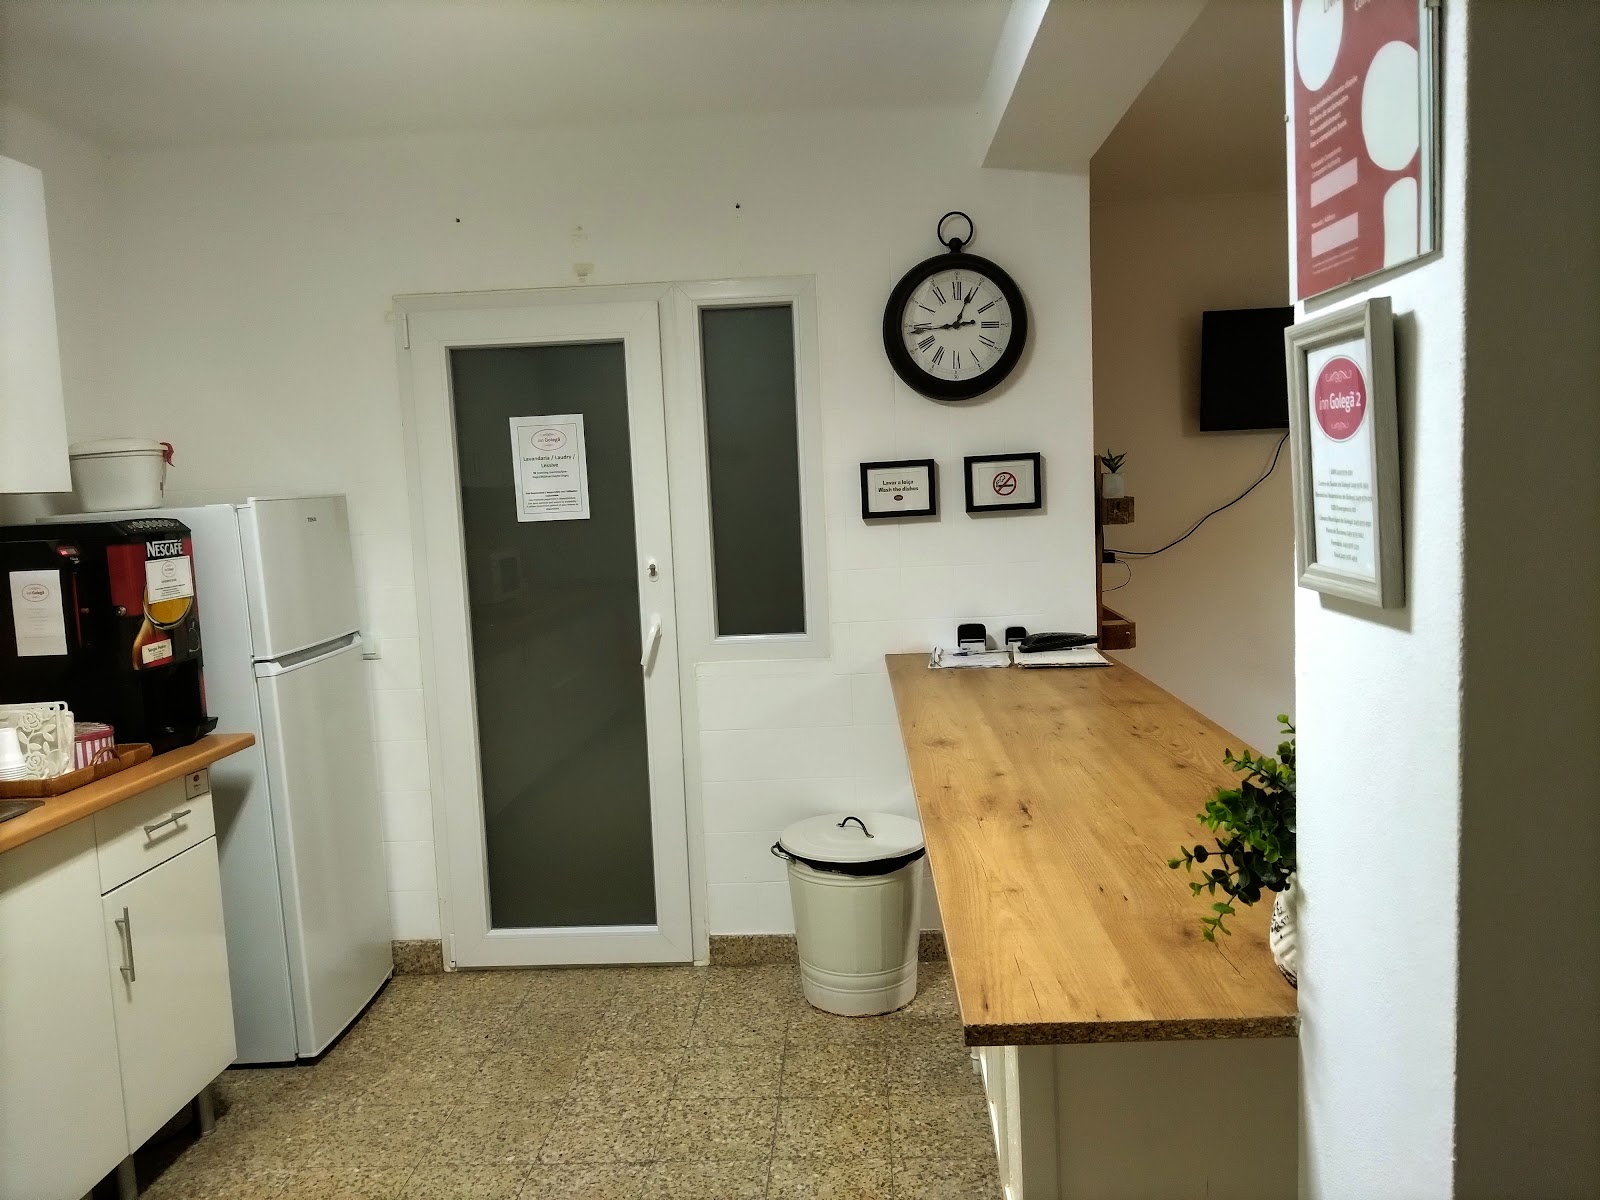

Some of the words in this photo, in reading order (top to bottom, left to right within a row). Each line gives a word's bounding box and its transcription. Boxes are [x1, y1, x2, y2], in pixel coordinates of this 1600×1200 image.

[1319, 396, 1329, 410] inn
[1330, 391, 1354, 412] Golegã
[1356, 392, 1362, 406] 2
[146, 538, 184, 558] NESCAFÉ
